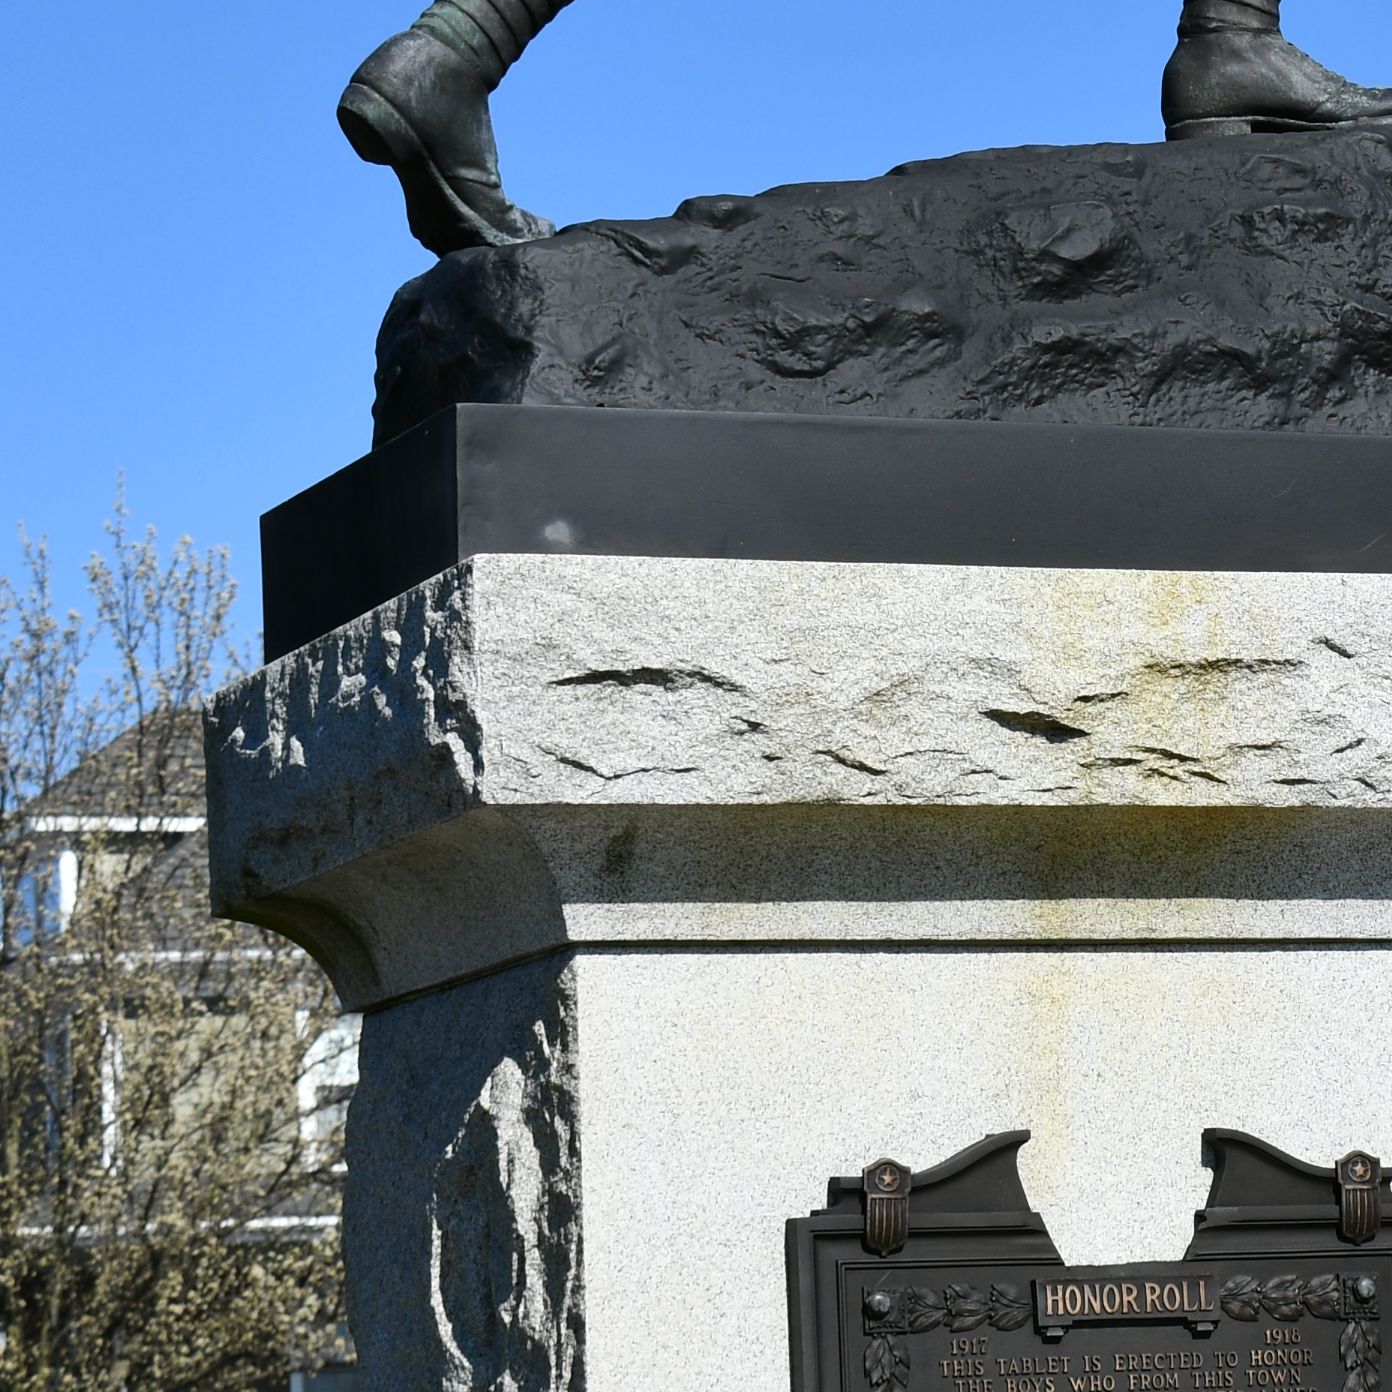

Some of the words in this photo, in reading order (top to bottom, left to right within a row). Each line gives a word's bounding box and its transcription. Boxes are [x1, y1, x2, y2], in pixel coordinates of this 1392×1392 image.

[1045, 1283, 1139, 1318] HONOR
[1145, 1280, 1215, 1314] ROLL
[951, 1337, 988, 1355] 1917
[1265, 1328, 1300, 1345] 1918
[939, 1359, 984, 1377] THIS
[997, 1357, 1070, 1375] TABLET
[1084, 1355, 1101, 1372] IS
[1115, 1353, 1203, 1371] ERECTED
[1215, 1352, 1238, 1368] TO
[1250, 1349, 1313, 1366] HONOR
[1069, 1375, 1115, 1392] WHO
[1128, 1372, 1179, 1391] FROM
[1192, 1371, 1233, 1388] THIS
[1246, 1369, 1300, 1386] TOWN
